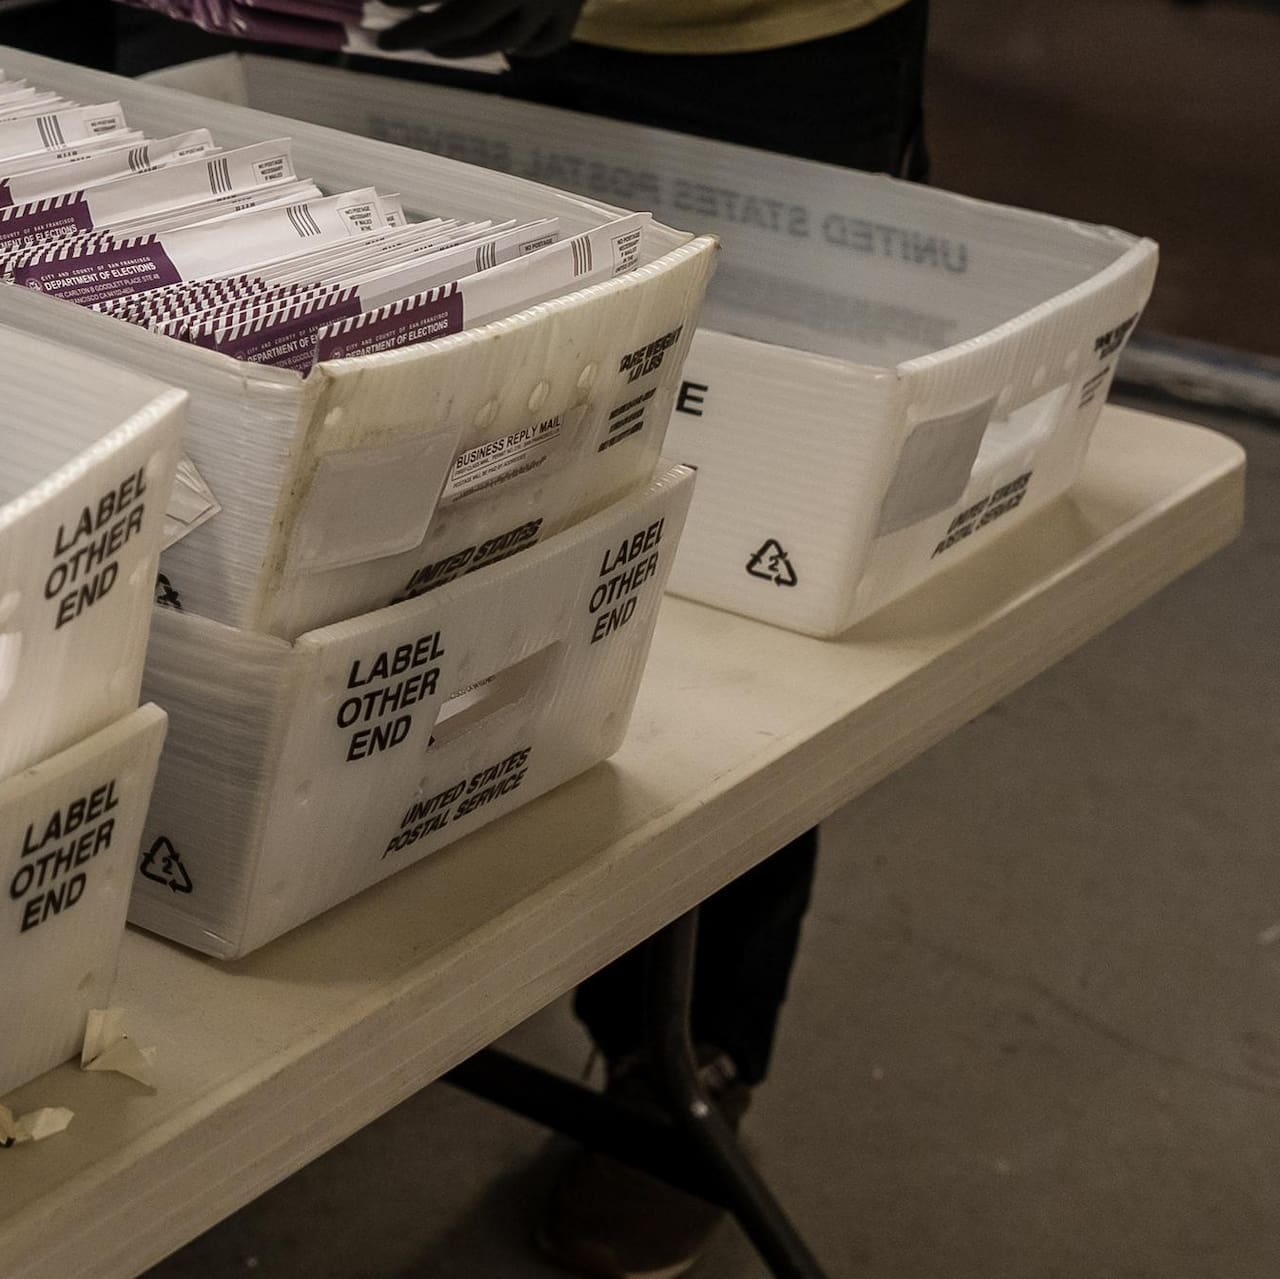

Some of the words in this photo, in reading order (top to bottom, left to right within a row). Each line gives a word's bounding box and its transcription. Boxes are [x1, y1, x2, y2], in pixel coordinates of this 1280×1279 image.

[44, 273, 99, 291] DEPARTMENT
[100, 269, 110, 280] OF
[111, 262, 156, 279] ELECTIONS
[73, 267, 94, 276] COUNTY
[119, 256, 151, 268] FRANCISCO
[345, 339, 395, 359] DEPARTMENT
[397, 334, 408, 345] OF
[408, 319, 448, 340] ELECTIONS
[376, 329, 396, 342] COUNTY
[420, 312, 448, 327] FRANCISCO
[455, 439, 505, 469] BUSINESS
[506, 425, 538, 448] REPLY
[539, 415, 561, 434] MAIL
[53, 468, 147, 558] LABEL
[45, 505, 146, 601] OTHER
[600, 518, 665, 578] LABEL
[55, 562, 118, 629] END
[589, 553, 657, 614] OTHER
[590, 596, 638, 645] END
[347, 632, 444, 689] LABEL
[337, 668, 440, 729] OTHER
[346, 718, 412, 763] END
[20, 779, 119, 858] LABEL
[382, 811, 450, 860] POSTAL
[454, 768, 528, 827] SERVICE
[401, 781, 469, 829] UNITED
[467, 748, 531, 796] STATES
[10, 818, 116, 902] OTHER
[161, 857, 173, 876] 2
[19, 872, 88, 933] END
